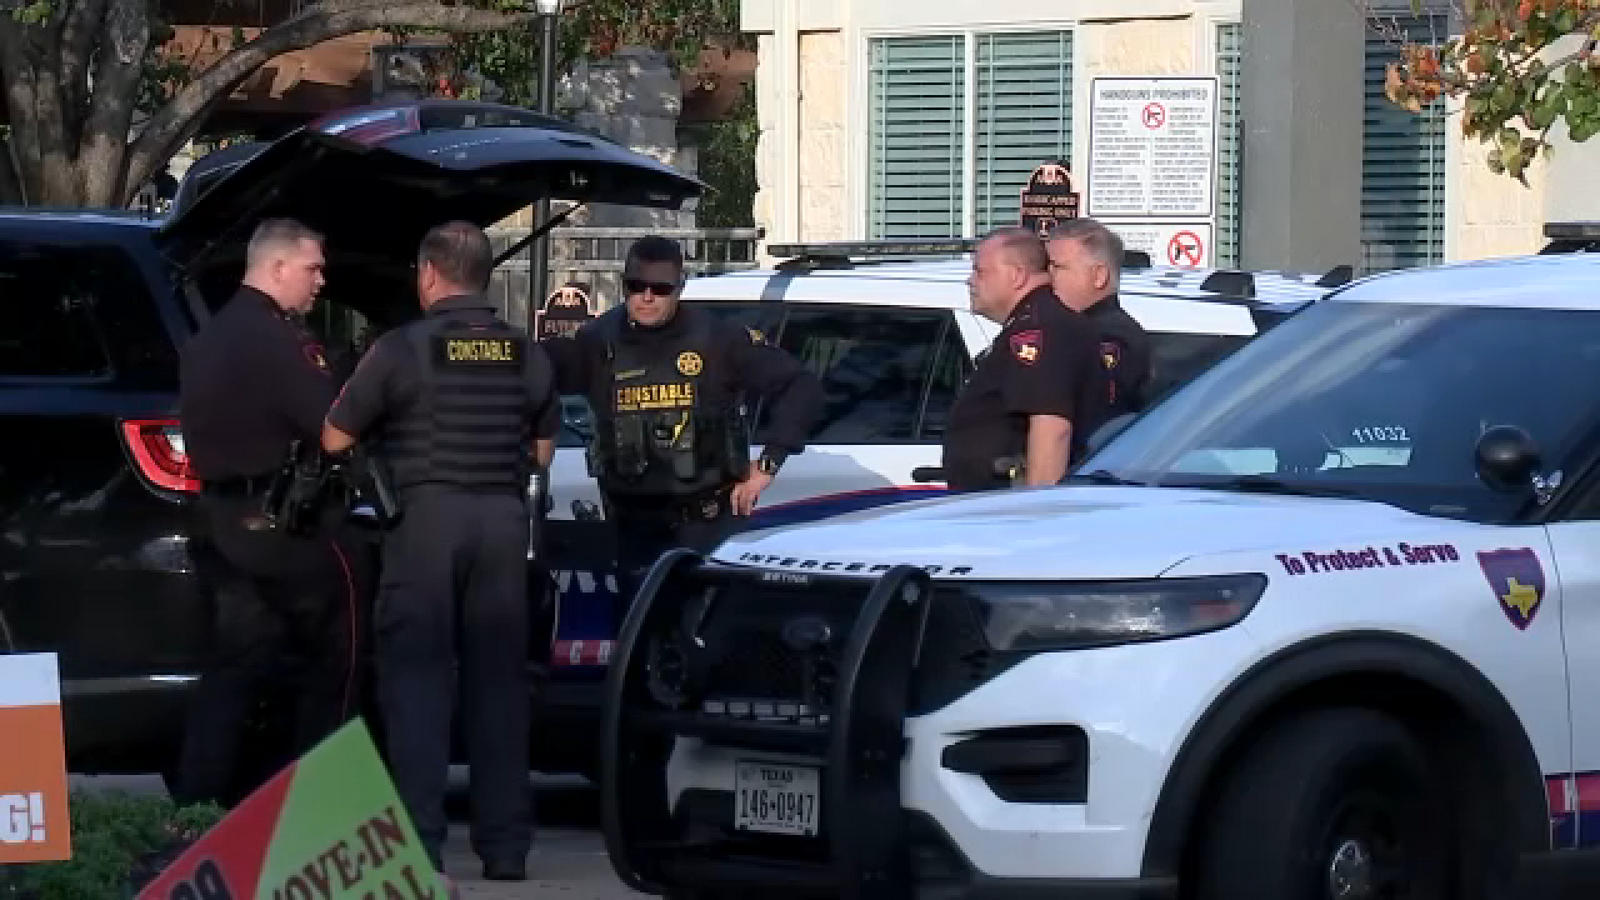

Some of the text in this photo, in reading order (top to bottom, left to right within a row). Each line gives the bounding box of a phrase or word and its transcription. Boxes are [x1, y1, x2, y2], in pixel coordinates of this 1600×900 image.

[1100, 88, 1208, 101] HANDGUNS PROHIBITED
[447, 340, 513, 361] CONSTABLE
[616, 382, 694, 404] CONSTABLE
[1352, 426, 1410, 443] 11032
[740, 552, 973, 574] INTERCEPOR
[1275, 542, 1460, 575] To Protect & Serve
[761, 769, 793, 783] TEXAS
